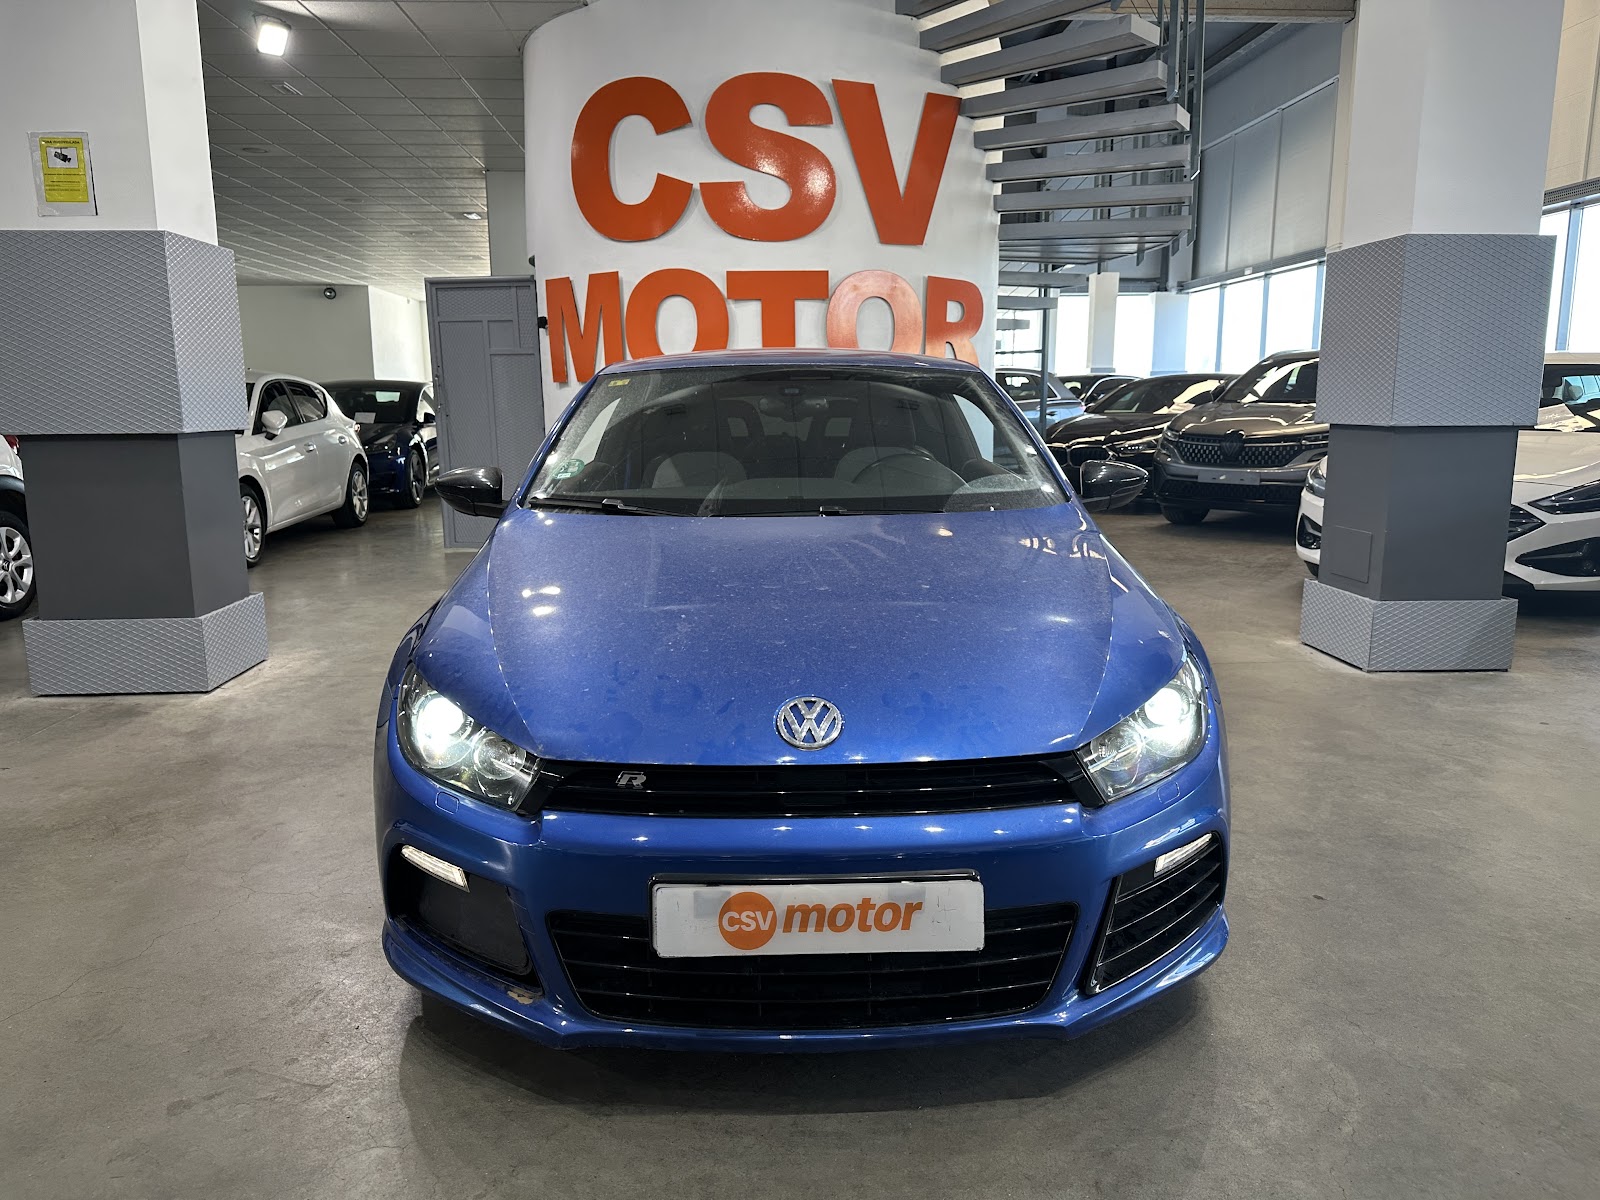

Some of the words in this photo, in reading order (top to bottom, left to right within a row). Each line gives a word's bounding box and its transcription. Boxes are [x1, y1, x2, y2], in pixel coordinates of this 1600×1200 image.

[571, 72, 962, 245] CSV
[545, 268, 984, 384] MOTOR
[616, 770, 647, 790] R
[782, 897, 923, 934] motor
